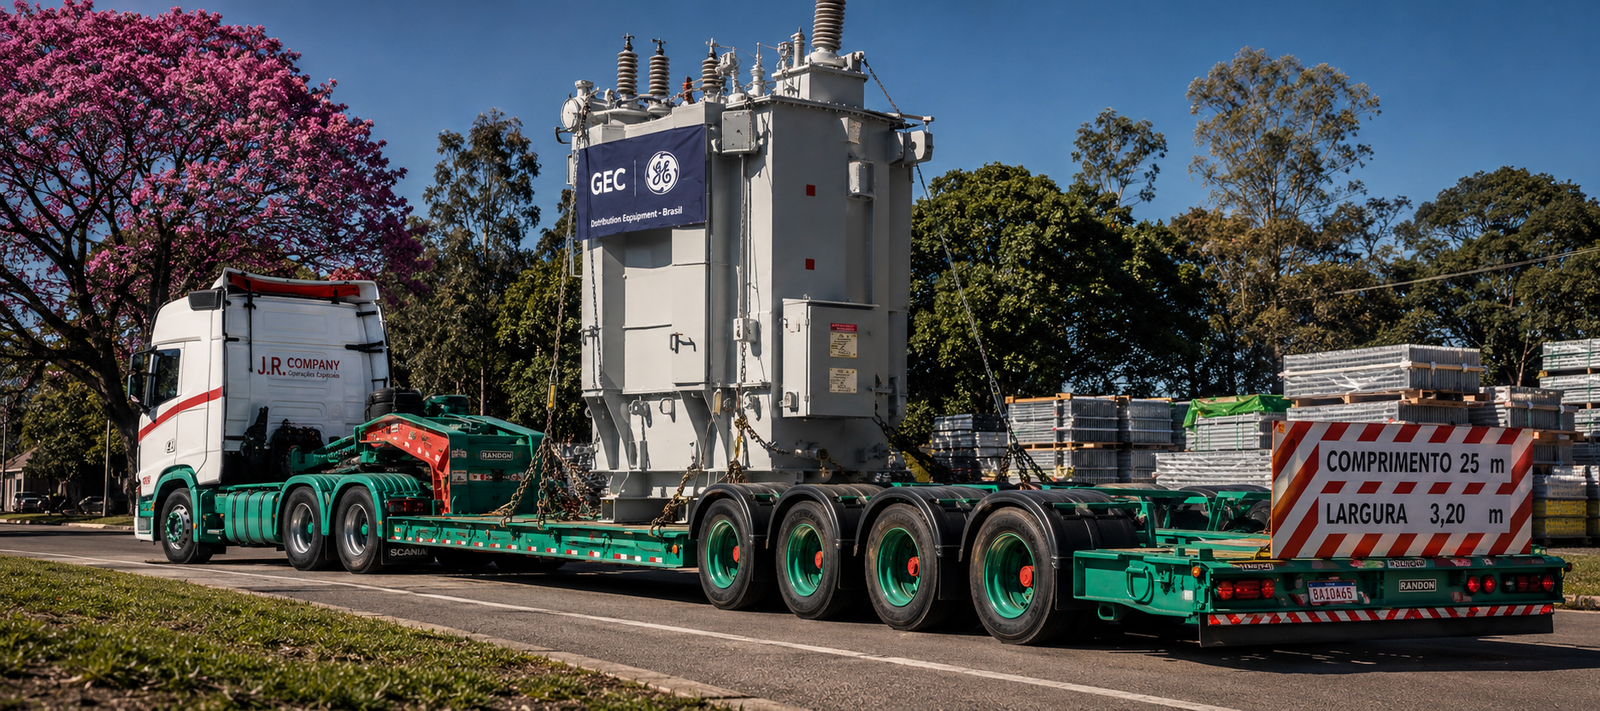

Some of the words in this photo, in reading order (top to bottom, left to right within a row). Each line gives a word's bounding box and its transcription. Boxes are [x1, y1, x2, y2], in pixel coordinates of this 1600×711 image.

[591, 167, 626, 195] GEC
[662, 206, 683, 216] Brasil
[257, 356, 287, 376] J.R.
[287, 357, 340, 370] COMPANY
[1326, 450, 1452, 473] COMPRIMENTO
[1460, 453, 1480, 473] 25
[1490, 457, 1505, 474] m
[1326, 503, 1408, 525] LARGURA
[1430, 503, 1466, 528] 3,20
[1488, 507, 1504, 524] m
[390, 548, 427, 557] SCANIA
[1400, 581, 1435, 591] RANDON
